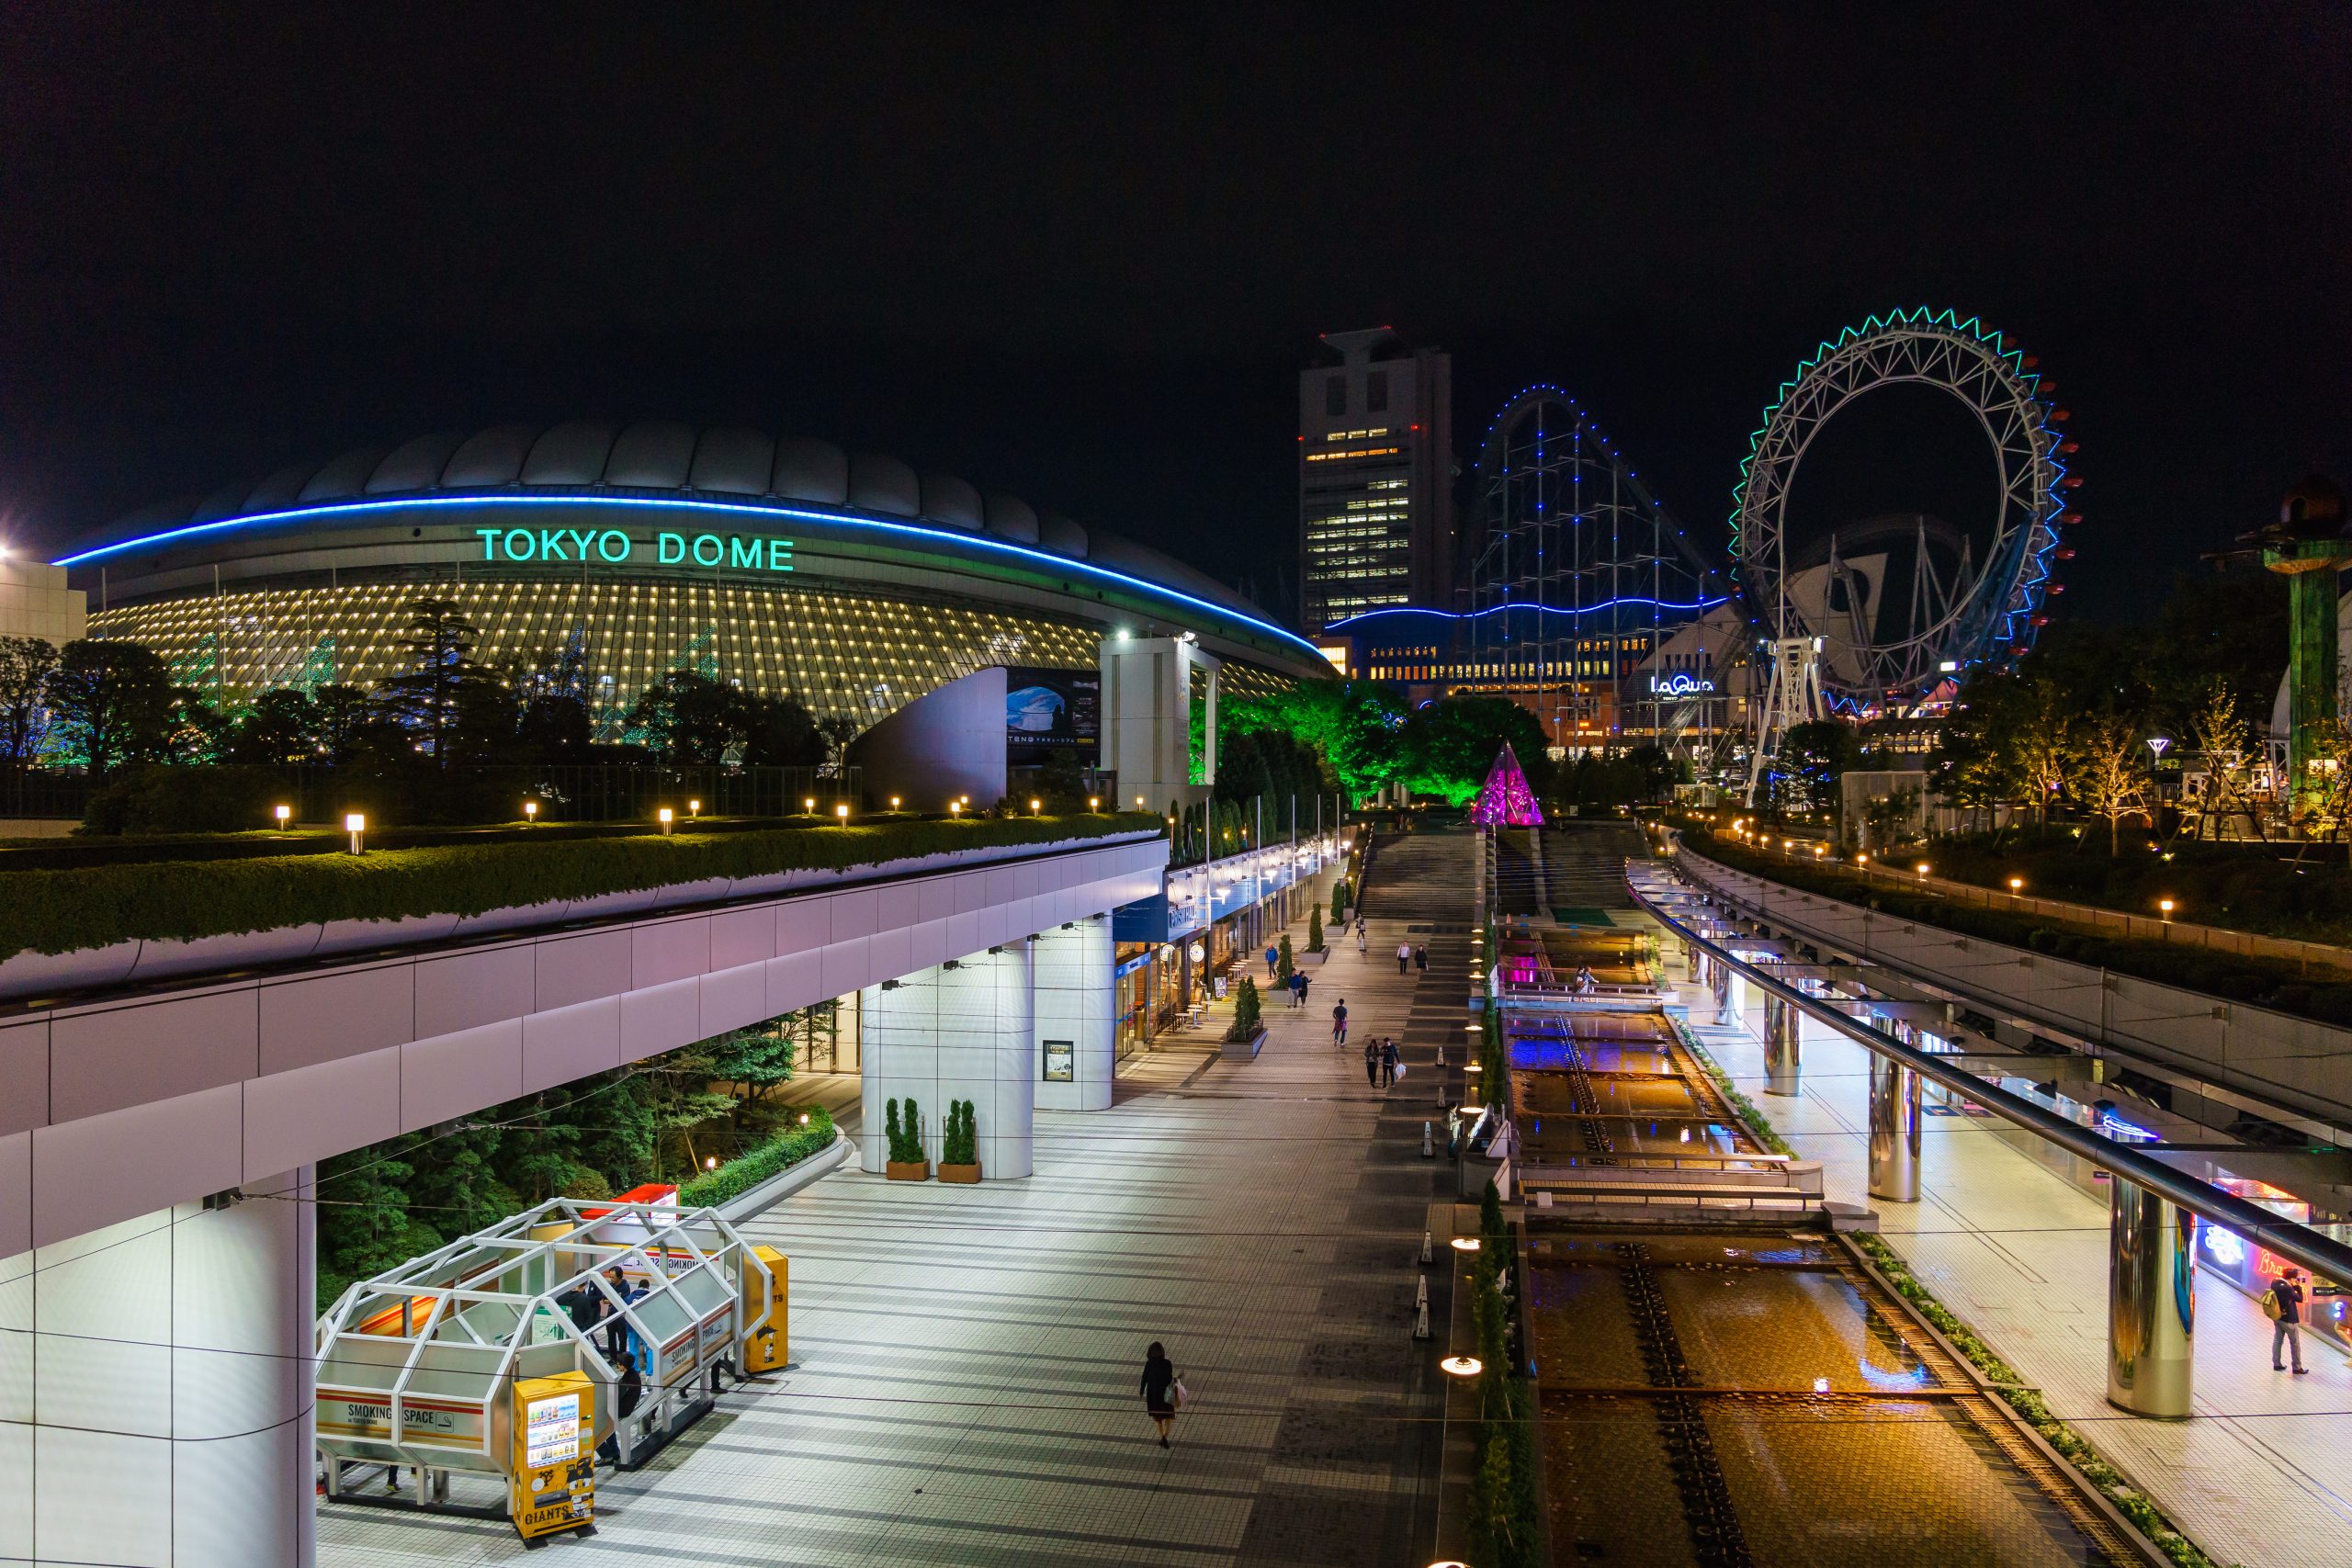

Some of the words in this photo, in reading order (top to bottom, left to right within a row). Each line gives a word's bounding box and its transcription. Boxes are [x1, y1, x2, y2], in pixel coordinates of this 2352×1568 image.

[476, 529, 631, 562] TOKYO
[659, 532, 794, 571] DOME
[672, 1338, 695, 1362] SMOKING
[702, 1325, 714, 1342] PACE
[347, 1404, 392, 1420] SMOKING
[403, 1409, 435, 1424] SPACE
[525, 1505, 570, 1525] GIANTS
